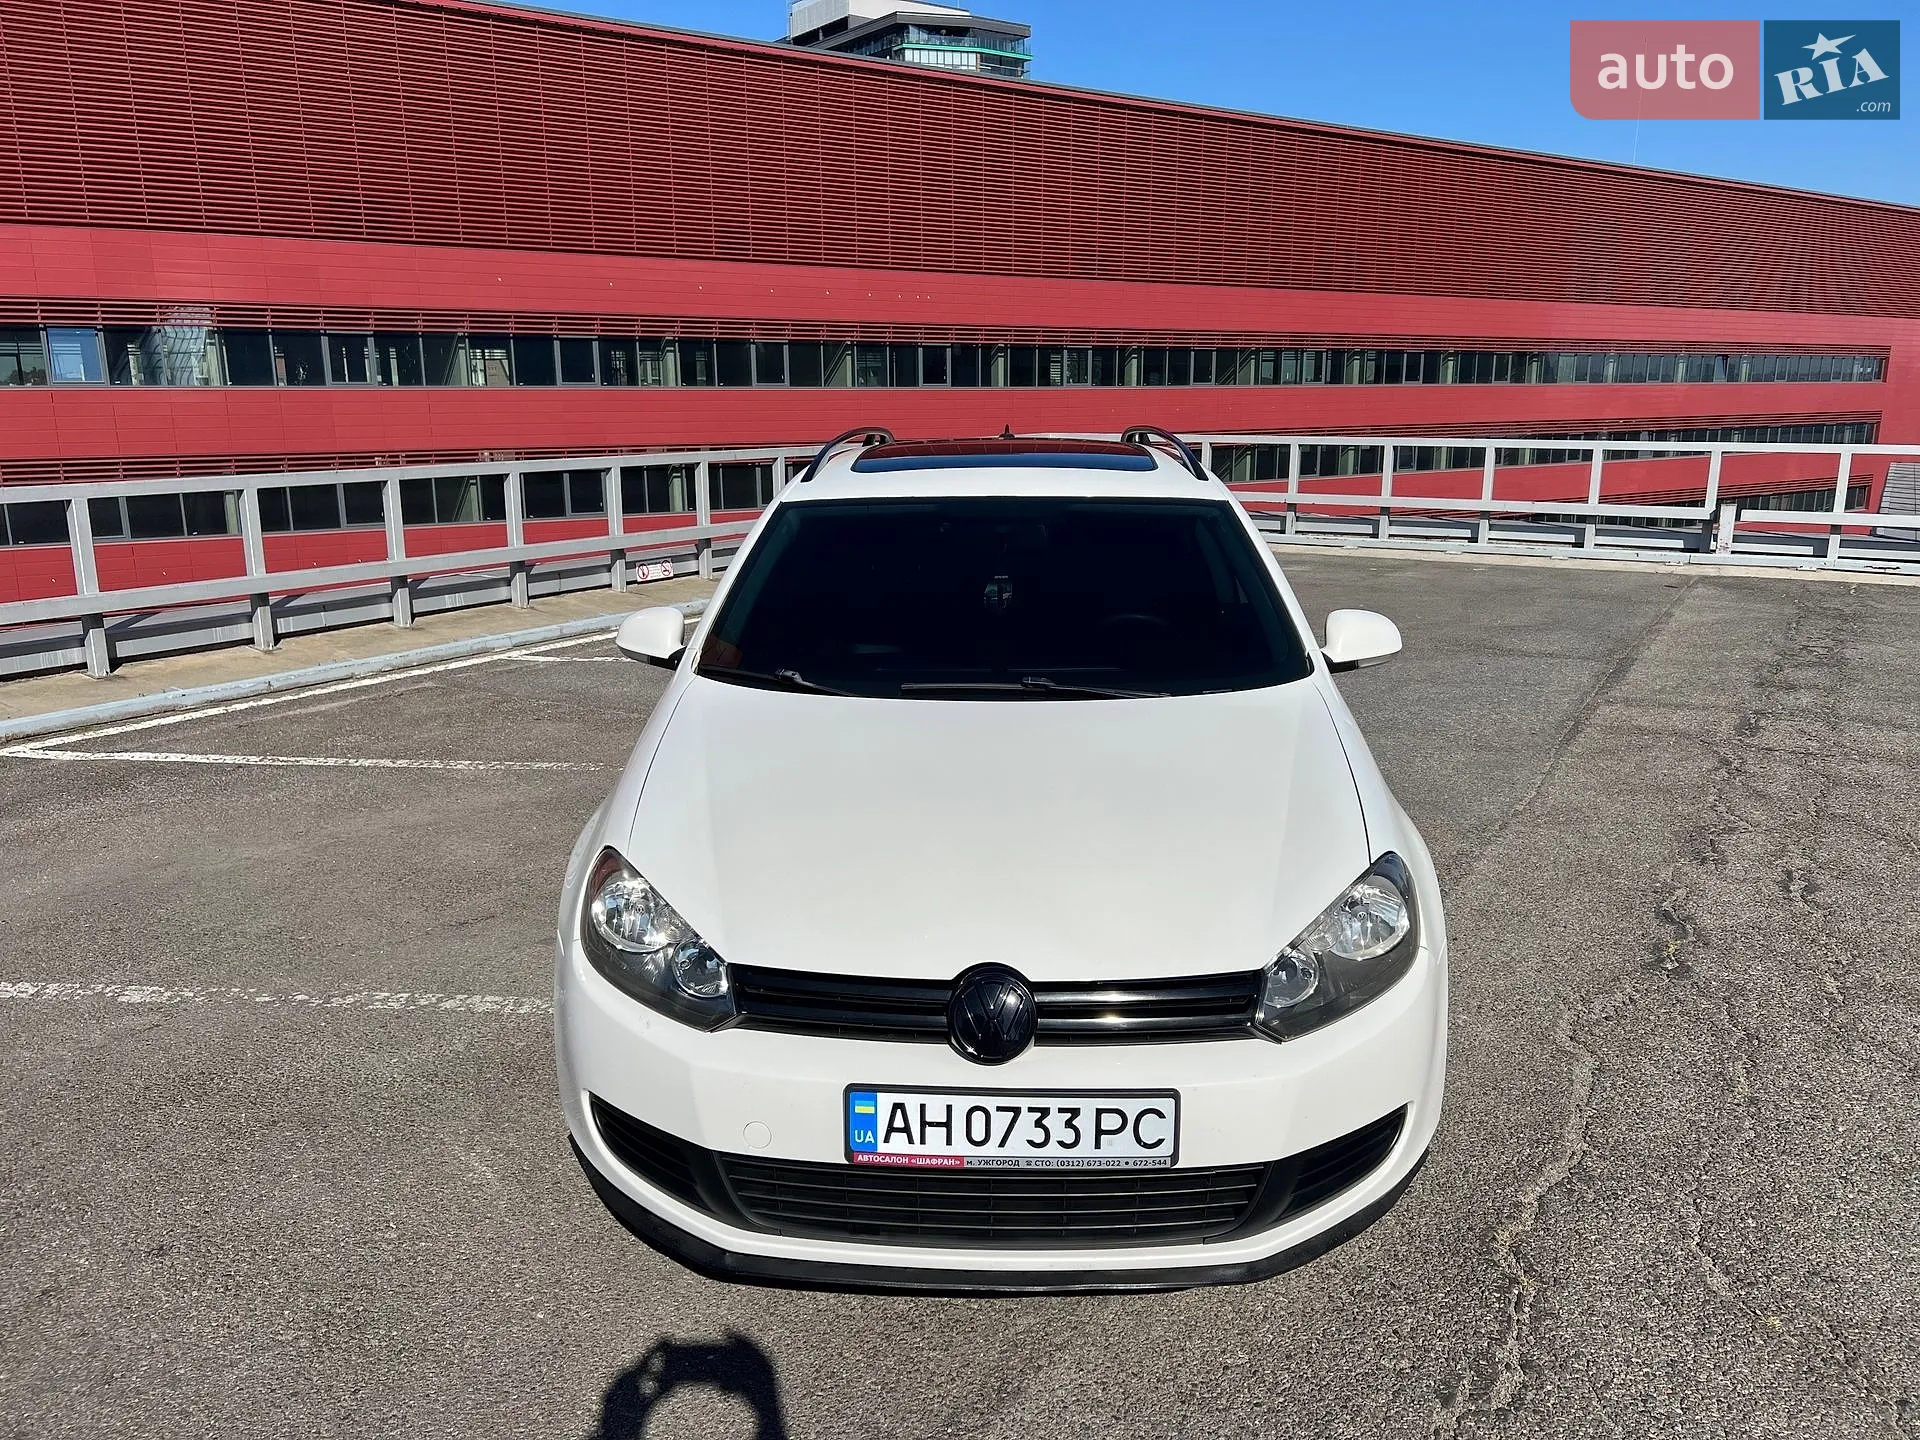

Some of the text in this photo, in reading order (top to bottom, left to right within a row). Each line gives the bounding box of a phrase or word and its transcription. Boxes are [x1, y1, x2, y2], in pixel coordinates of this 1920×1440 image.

[883, 1102, 1167, 1150] AH 0733 PC
[855, 1130, 875, 1144] UA
[857, 1154, 960, 1166] АВТОСАЛОН «ШАФРАН»
[977, 1159, 1020, 1167] УЖГОРОД
[1056, 1159, 1085, 1168] (0312)
[1086, 1159, 1121, 1167] 673-022
[1132, 1159, 1167, 1167] 672-544
